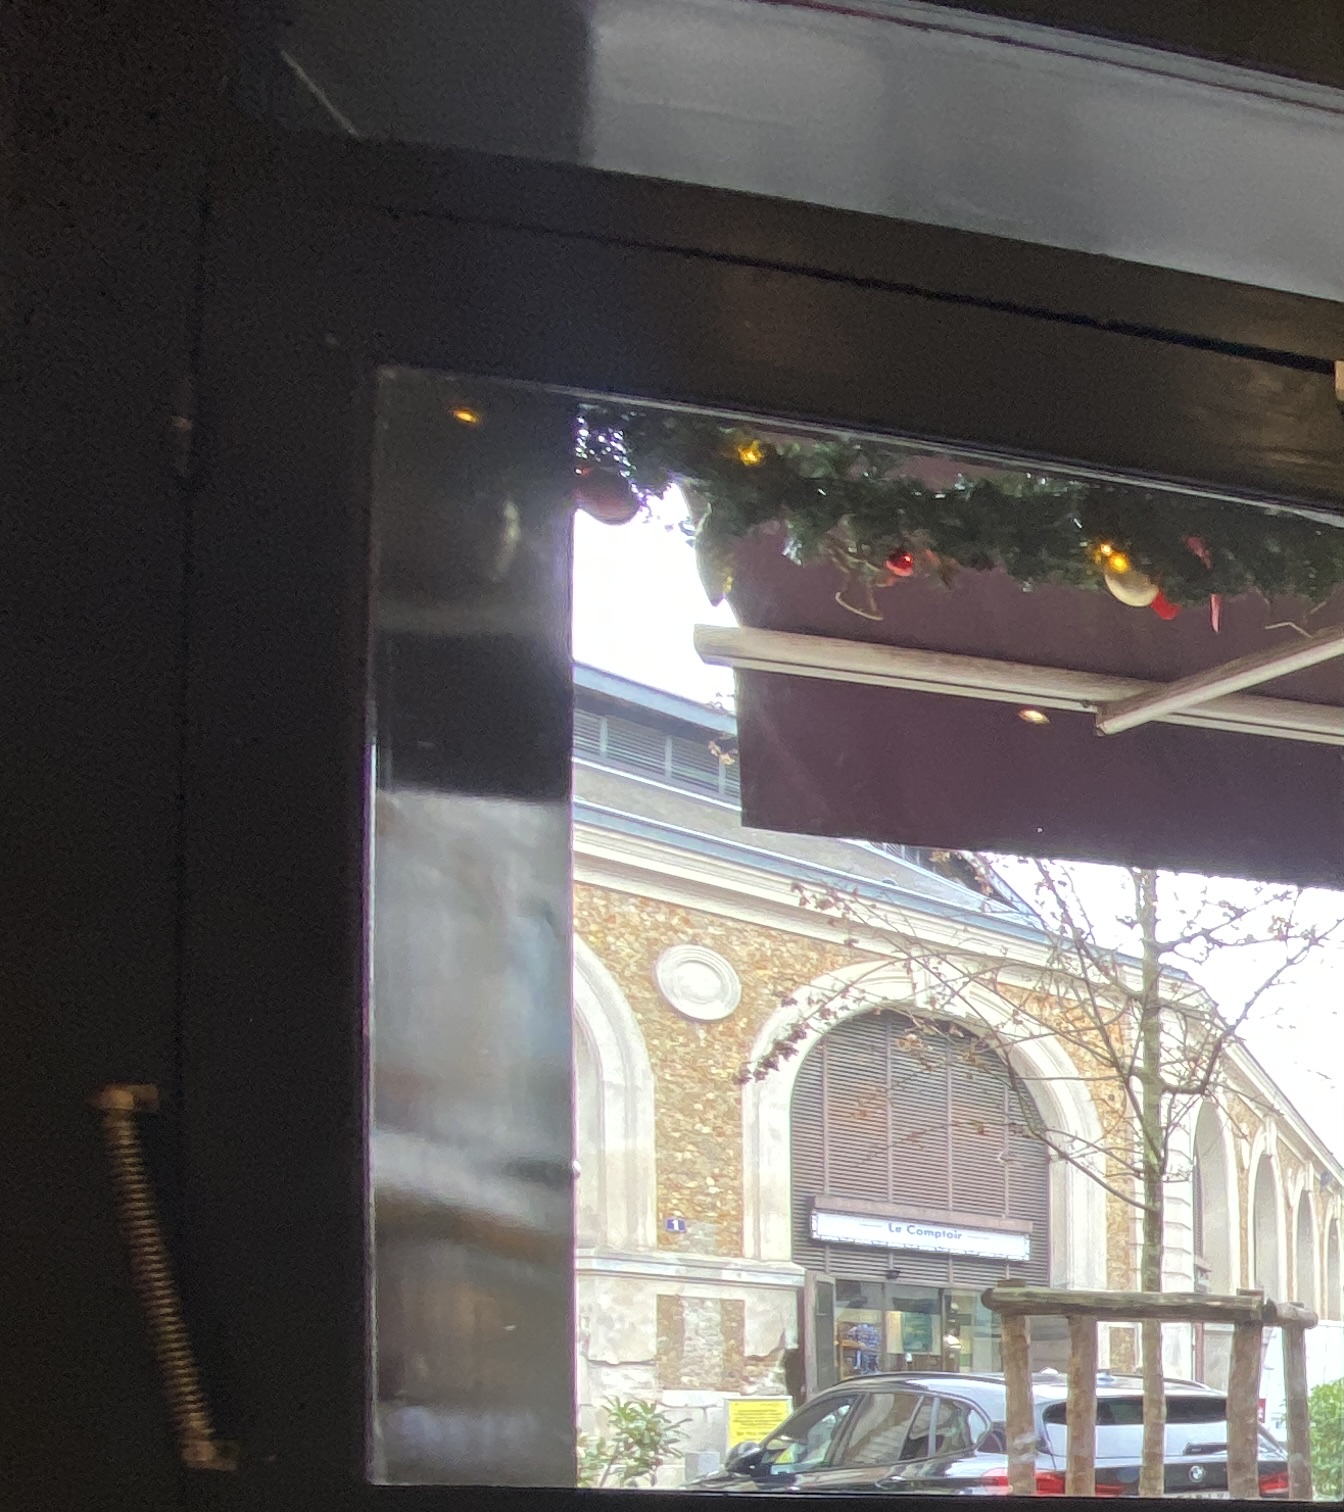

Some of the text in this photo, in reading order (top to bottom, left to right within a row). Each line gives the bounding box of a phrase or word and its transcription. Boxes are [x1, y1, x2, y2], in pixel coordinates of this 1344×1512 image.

[671, 1219, 680, 1231] 1
[887, 1222, 964, 1242] Le Comptoir
